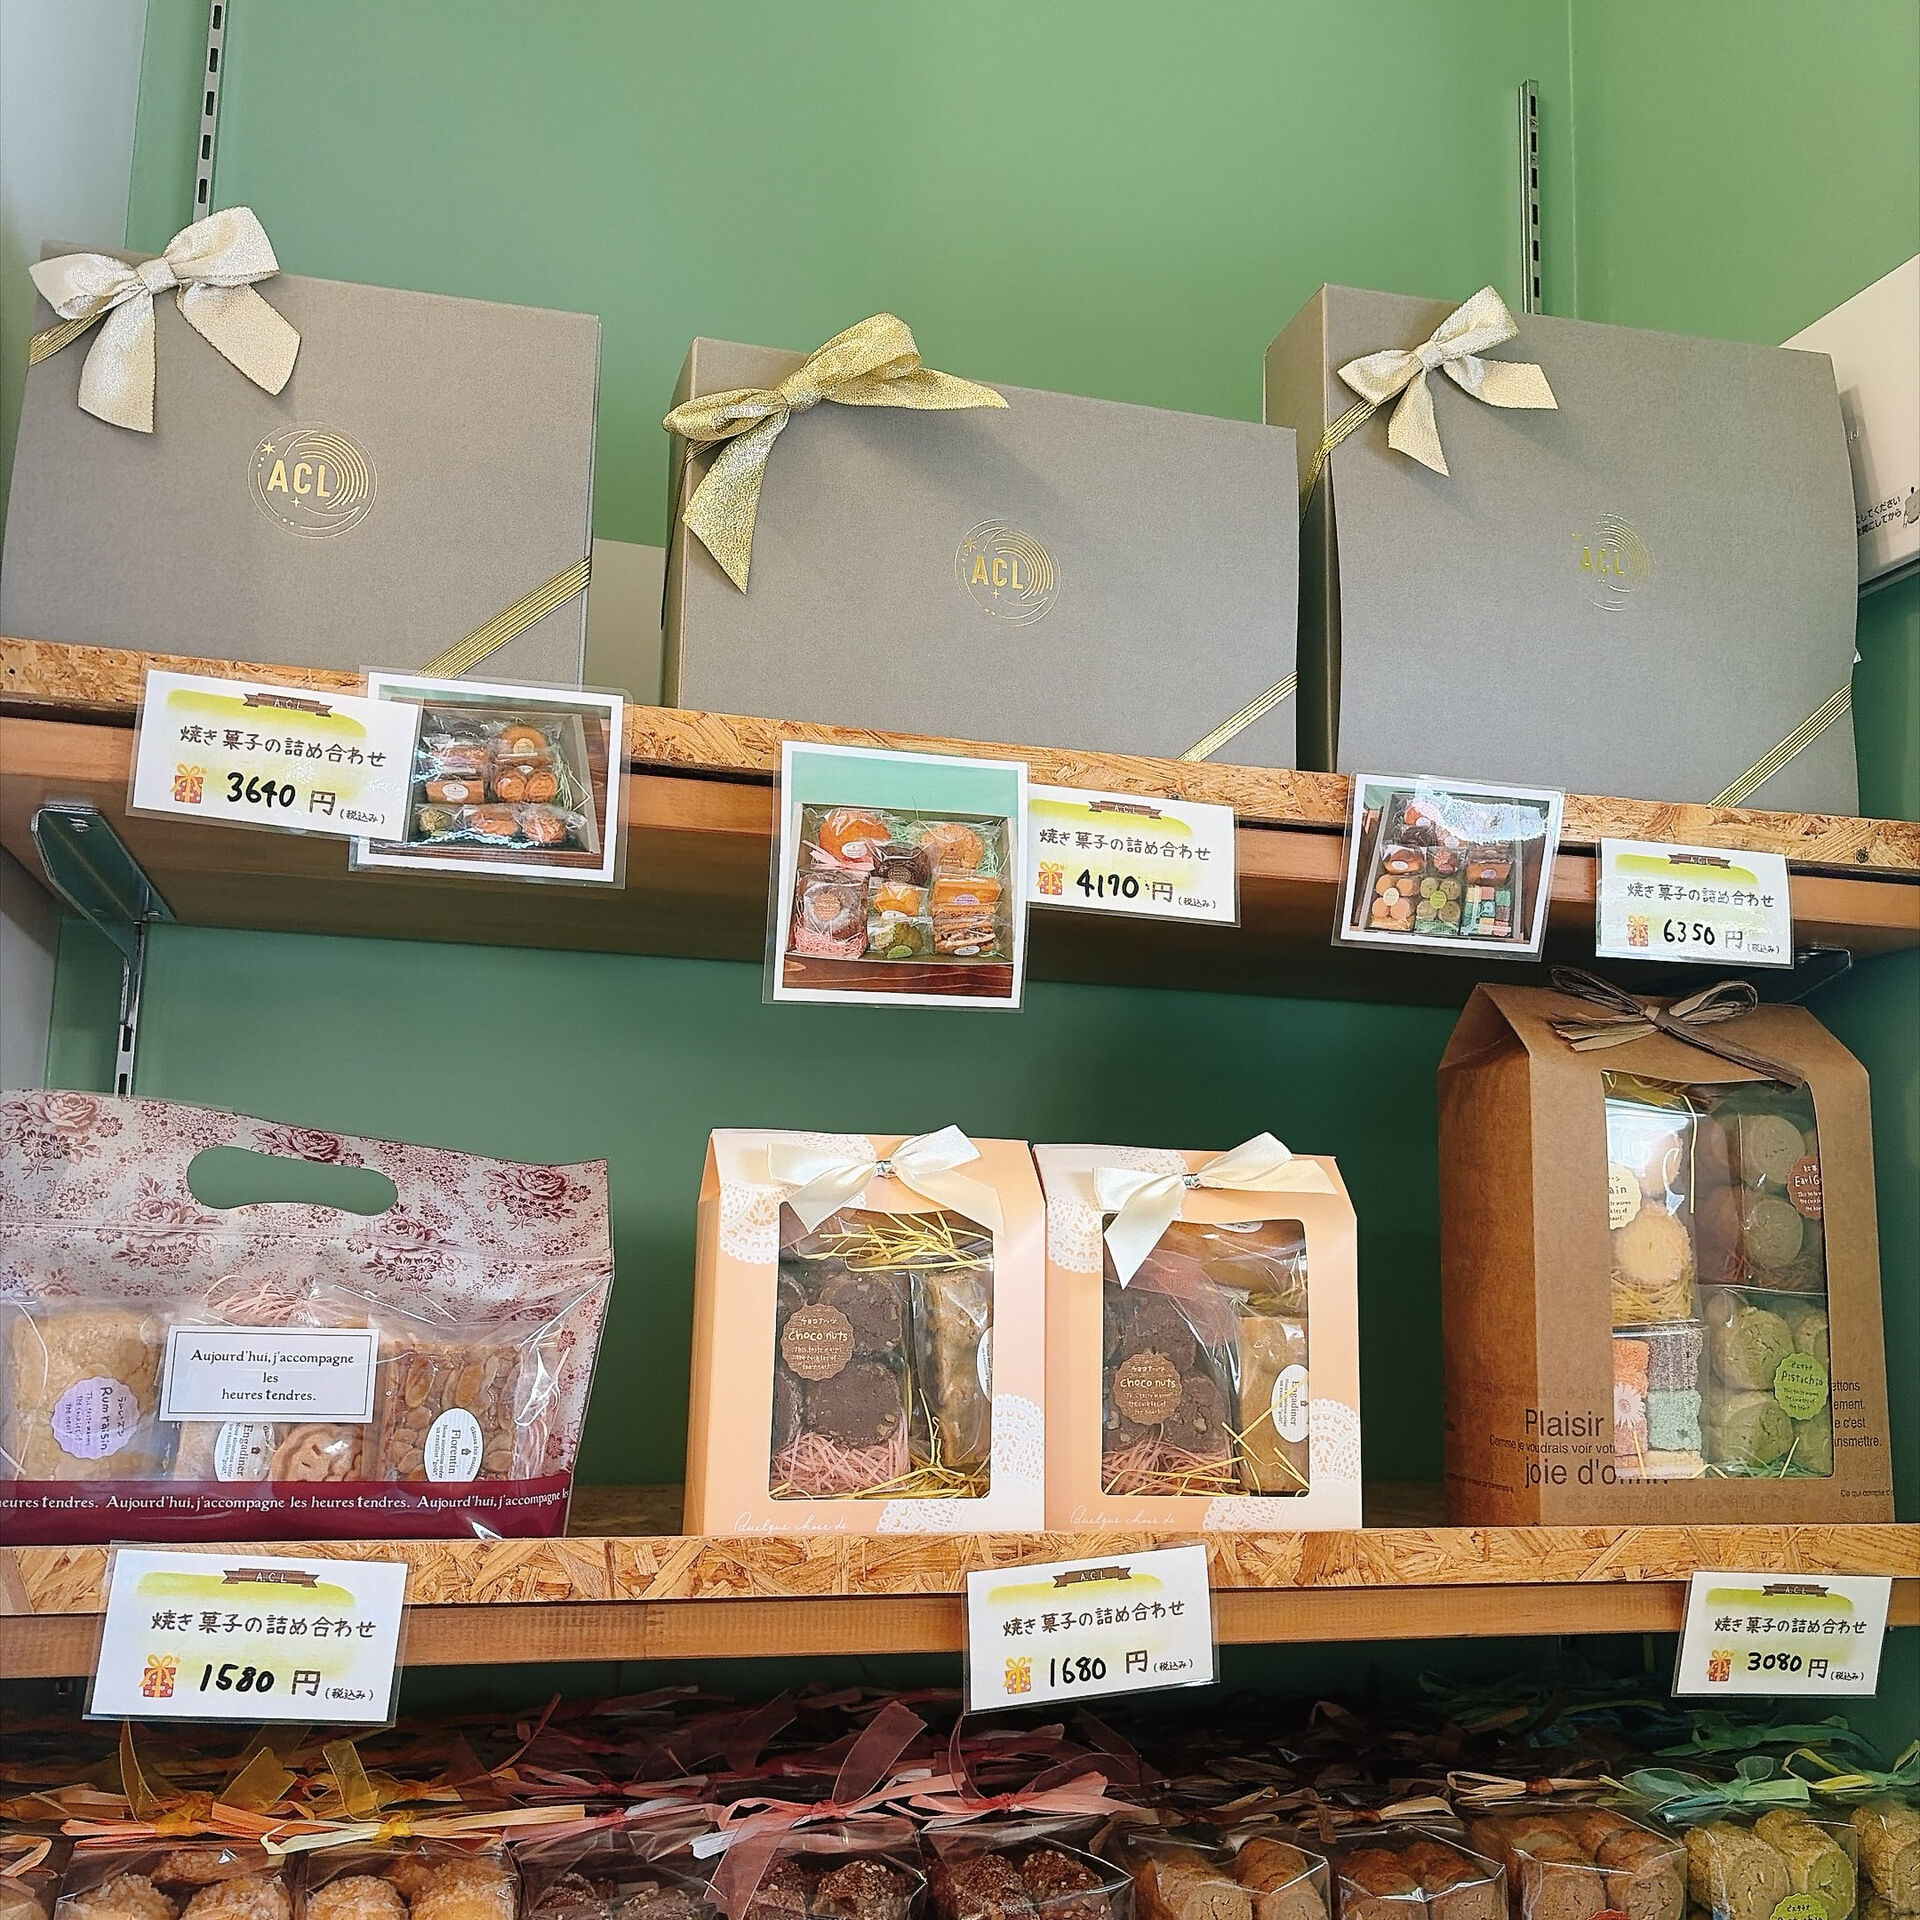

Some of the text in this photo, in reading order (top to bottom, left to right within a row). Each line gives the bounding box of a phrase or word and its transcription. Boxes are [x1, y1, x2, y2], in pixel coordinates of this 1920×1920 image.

[267, 459, 331, 498] ACL
[971, 554, 1024, 590] ACL
[1580, 546, 1624, 577] ACL
[180, 724, 387, 768] 焼き菓子の詰め合わせ
[226, 771, 385, 825] 3640 円 (税込み)
[1039, 828, 1211, 861] 焼き菓子の詰め合わせ
[1076, 869, 1217, 909] 4170 円 (税込み)
[1627, 881, 1775, 908] 焼き菓子の詰め合わせ
[1663, 918, 1716, 946] 6350
[1725, 930, 1743, 950] 円
[826, 1330, 848, 1342] nuts
[190, 1349, 354, 1367] Aujourd'hui, j'accompagne
[262, 1372, 279, 1384] les
[1155, 1377, 1176, 1388] nuts
[221, 1388, 317, 1401] heures tendres.
[100, 1386, 113, 1450] Rum raisin
[1524, 1408, 1604, 1437] Plaisir
[1843, 1417, 1866, 1429] c'est
[237, 1424, 254, 1476] Engadiner
[448, 1429, 461, 1474] Florentin
[1526, 1441, 1569, 1454] voudrais
[1571, 1442, 1592, 1454] voir
[1524, 1456, 1568, 1489] joie
[41, 1495, 99, 1509] tendres.
[105, 1495, 194, 1512] Aujourd'hui,
[195, 1495, 285, 1512] j'accompagne
[290, 1496, 308, 1508] les
[311, 1496, 355, 1509] heures
[357, 1495, 411, 1509] tendres.
[416, 1495, 497, 1512] Aujourd'hui,
[498, 1490, 561, 1511] j'accompagne
[151, 1608, 377, 1639] 焼き菓子の詰め合わせ
[1002, 1600, 1185, 1637] 焼き菓子の詰め合わせ
[1713, 1615, 1868, 1635] 焼き菓子の詰め合わせ
[1049, 1649, 1193, 1687] 1680 円 (税込み)
[1747, 1651, 1865, 1681] 3080 円 (税込み)
[199, 1662, 374, 1702] 1580 円 (税込み)
